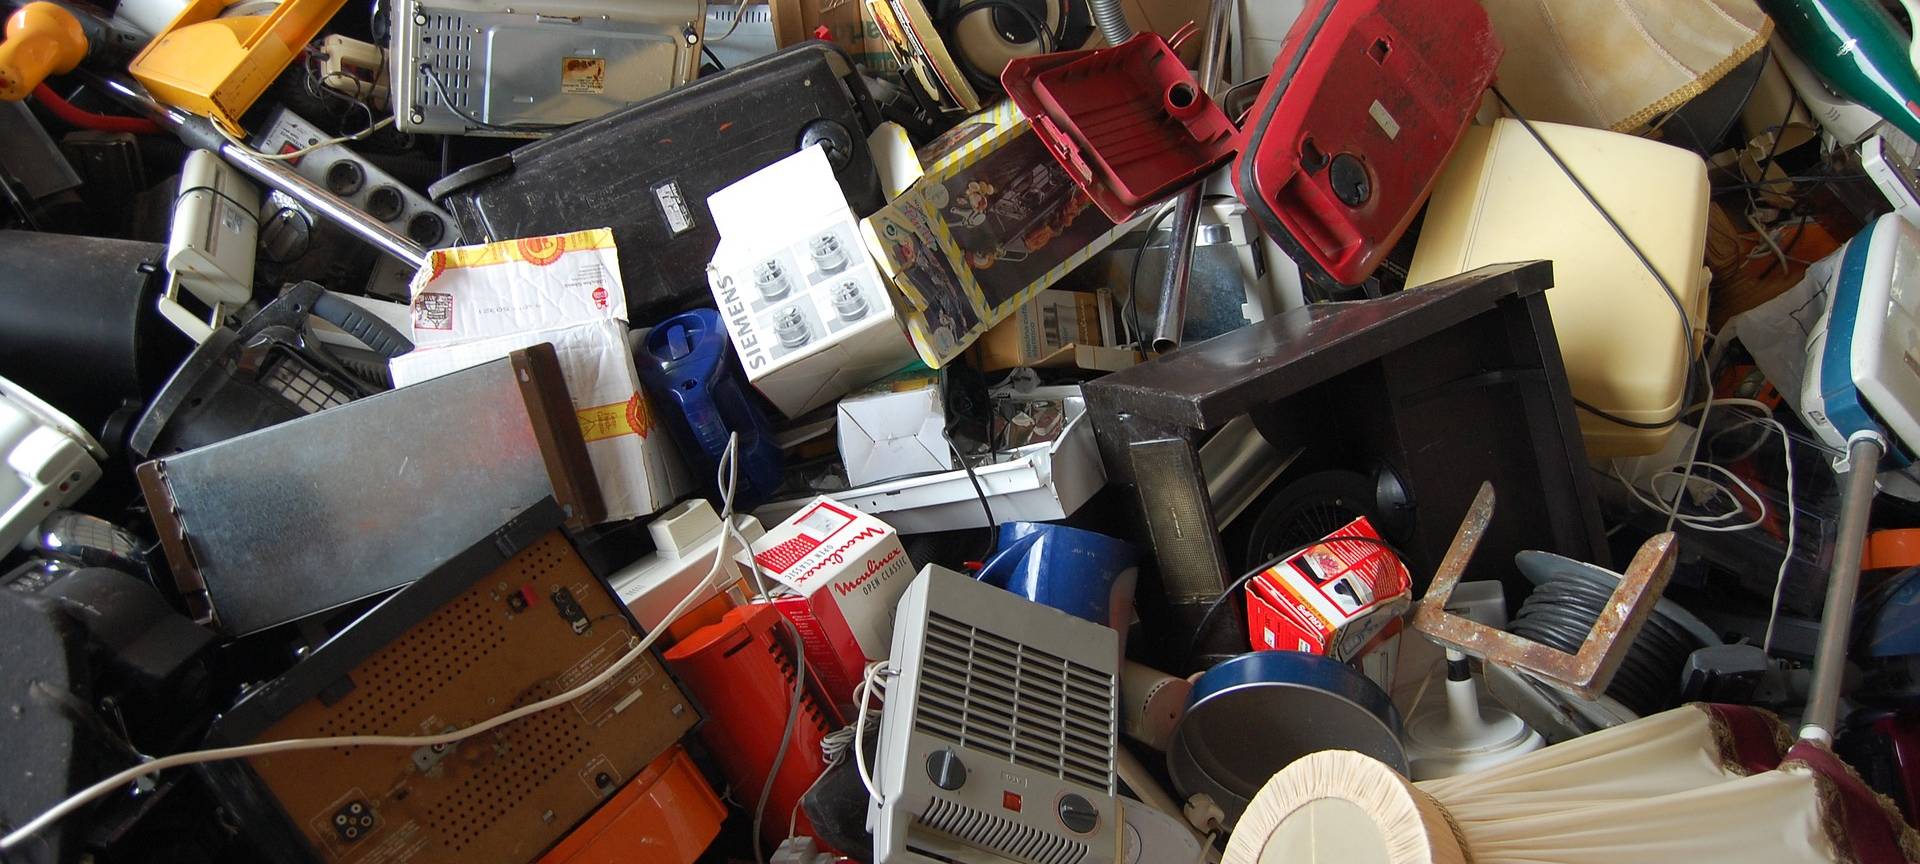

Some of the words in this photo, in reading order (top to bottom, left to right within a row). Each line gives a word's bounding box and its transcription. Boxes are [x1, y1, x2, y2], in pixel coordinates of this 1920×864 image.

[717, 275, 766, 370] SIEMENS
[784, 558, 815, 581] CLASSIC
[794, 526, 885, 584] Moulinex
[815, 543, 834, 560] OPEN
[834, 547, 901, 596] Moulinex
[862, 580, 881, 595] OPEN
[882, 556, 908, 579] CLASSIC
[1296, 604, 1325, 630] KRUPS
